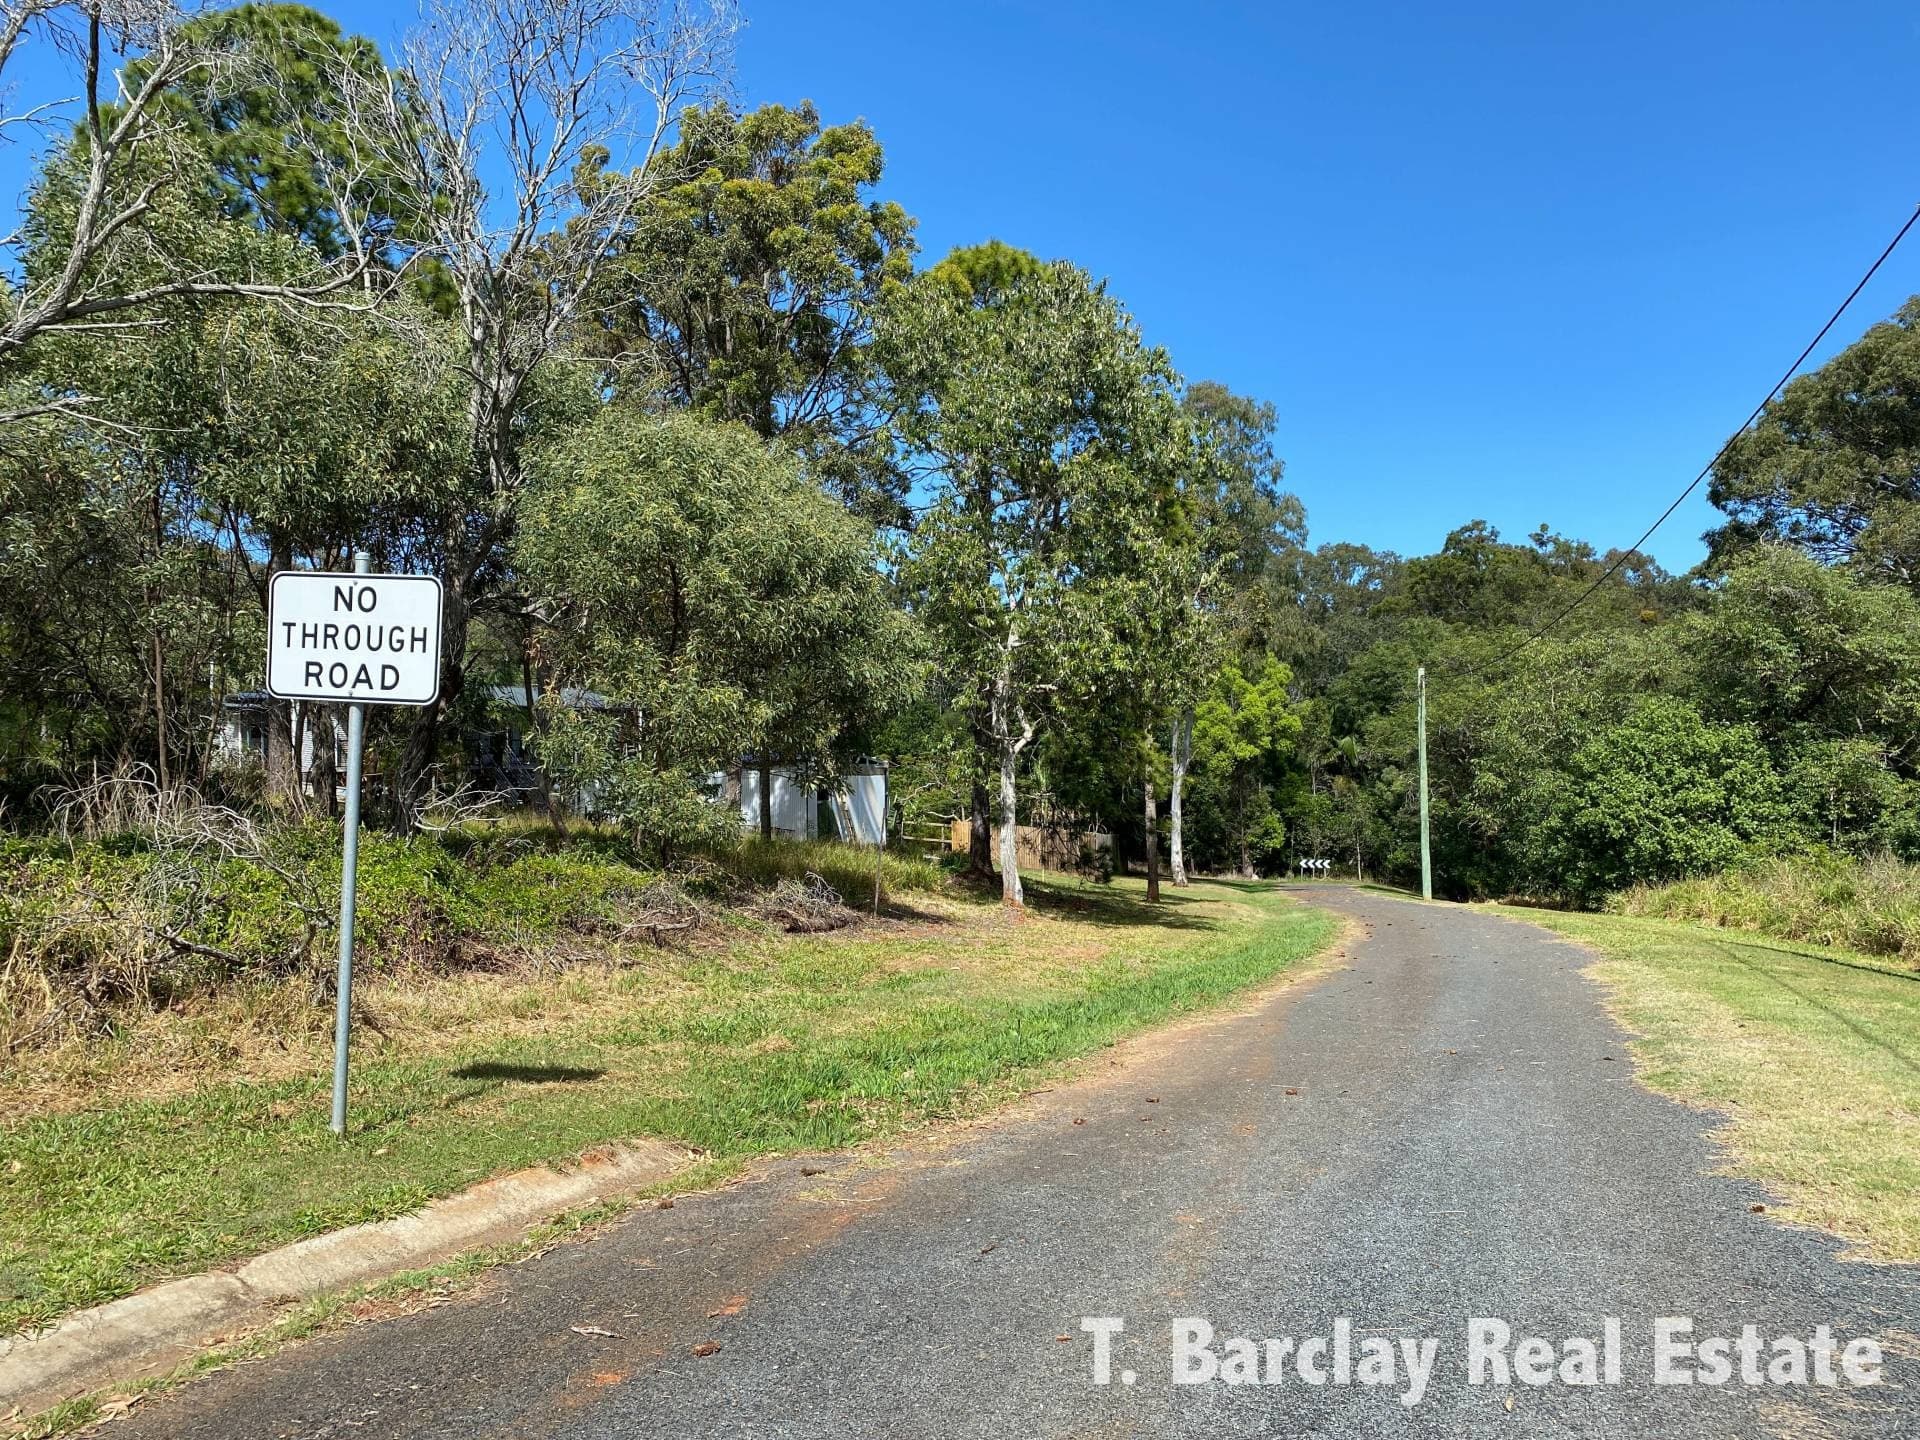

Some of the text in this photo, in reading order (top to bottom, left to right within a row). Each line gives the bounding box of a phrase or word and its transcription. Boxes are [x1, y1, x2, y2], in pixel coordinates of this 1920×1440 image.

[334, 585, 377, 613] NO
[282, 621, 428, 654] THROUGH
[304, 660, 400, 691] ROAD
